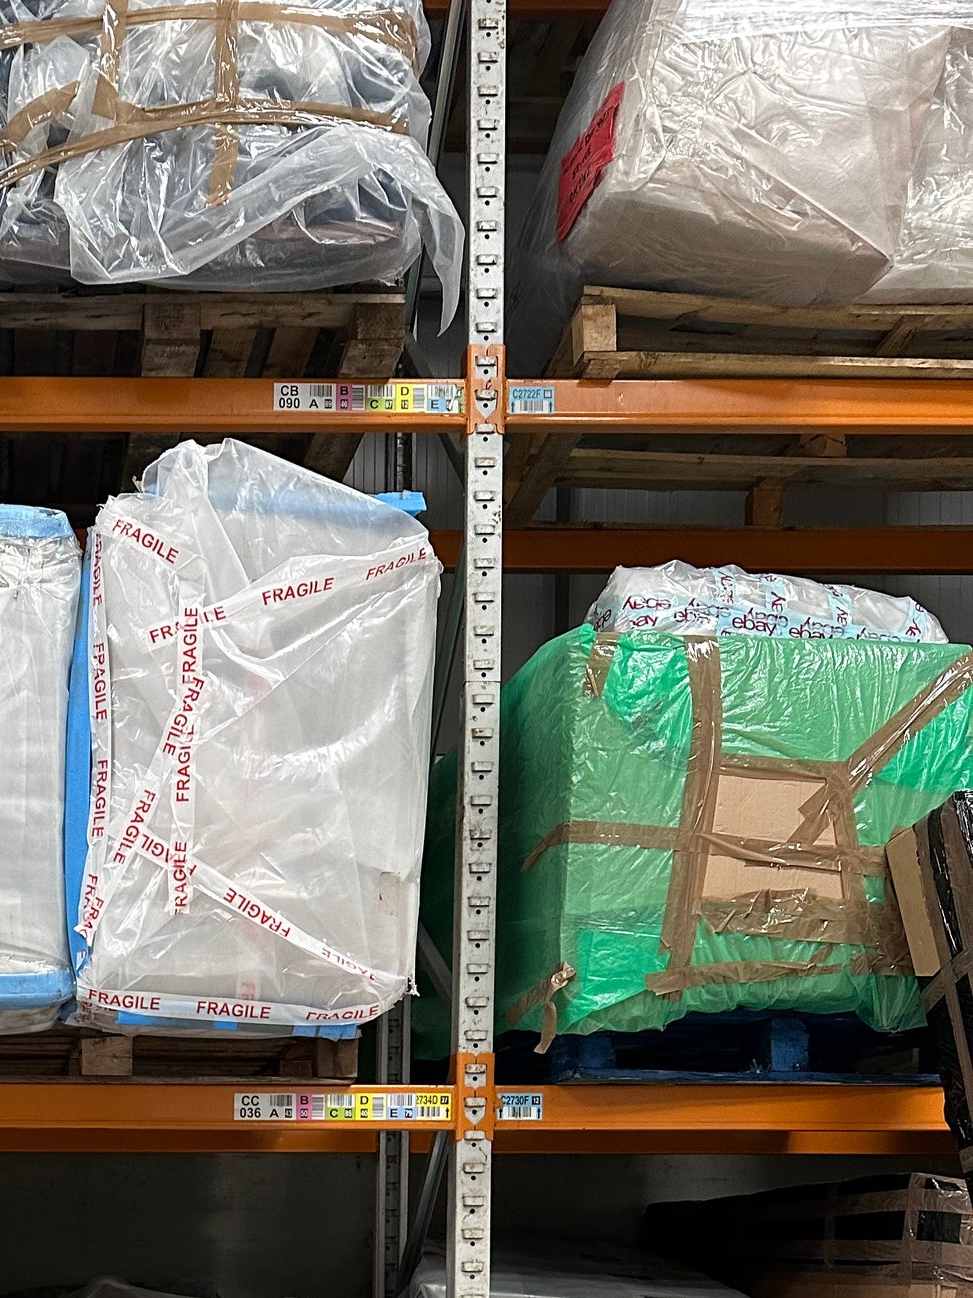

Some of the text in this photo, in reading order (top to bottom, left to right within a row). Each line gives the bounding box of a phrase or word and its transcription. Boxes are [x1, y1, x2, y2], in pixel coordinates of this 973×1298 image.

[278, 397, 301, 409] 090
[309, 399, 319, 409] A
[368, 400, 379, 409] C
[430, 400, 440, 410] E
[280, 385, 410, 397] CB B D
[512, 389, 541, 399] C2722F
[112, 519, 179, 564] FRAGILE
[366, 547, 427, 581] FRAGILE
[262, 577, 335, 606] FRAGILE
[732, 614, 777, 636] ebay
[182, 607, 198, 684] FRAGILE
[93, 643, 107, 721] FRAGILE
[163, 676, 205, 757] FRAGILE
[91, 759, 109, 838] FRAGILE
[113, 789, 157, 865] FRAGILE
[173, 841, 188, 915] FRAGILE
[222, 887, 292, 938] FRAGILE
[88, 989, 161, 1010] FRAGILE
[196, 1001, 272, 1019] FRAGILE
[305, 1005, 379, 1021] FRAGILE
[239, 1107, 261, 1118] 036
[269, 1109, 279, 1118] A
[329, 1108, 339, 1118] C
[390, 1109, 398, 1118] E
[241, 1095, 369, 1106] CC B D
